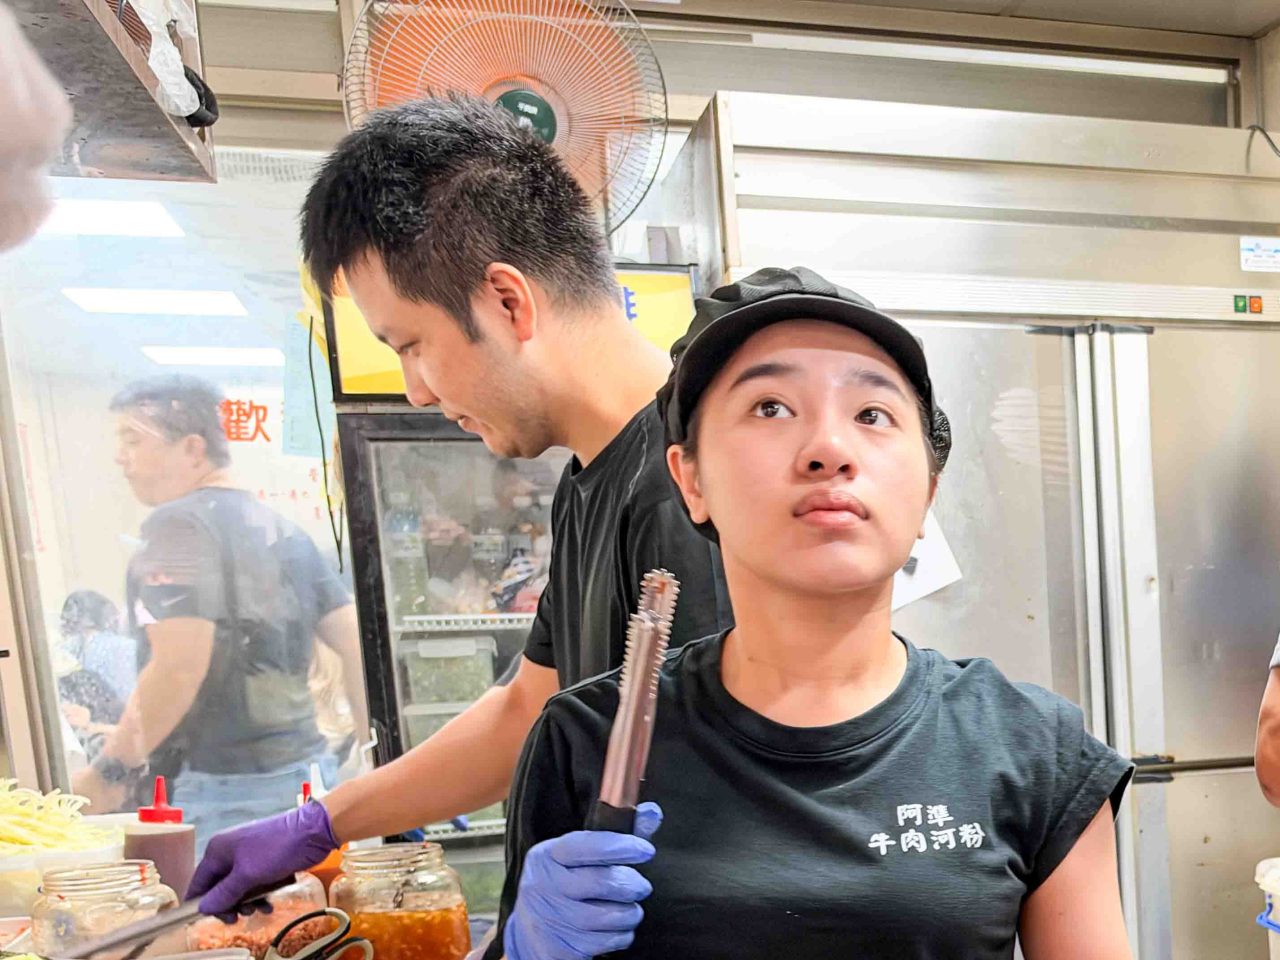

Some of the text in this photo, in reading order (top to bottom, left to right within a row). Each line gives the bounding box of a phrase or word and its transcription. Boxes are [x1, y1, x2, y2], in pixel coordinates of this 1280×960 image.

[218, 399, 272, 442] 歡
[896, 803, 954, 827] 阿準
[867, 822, 986, 856] 牛肉河粉
